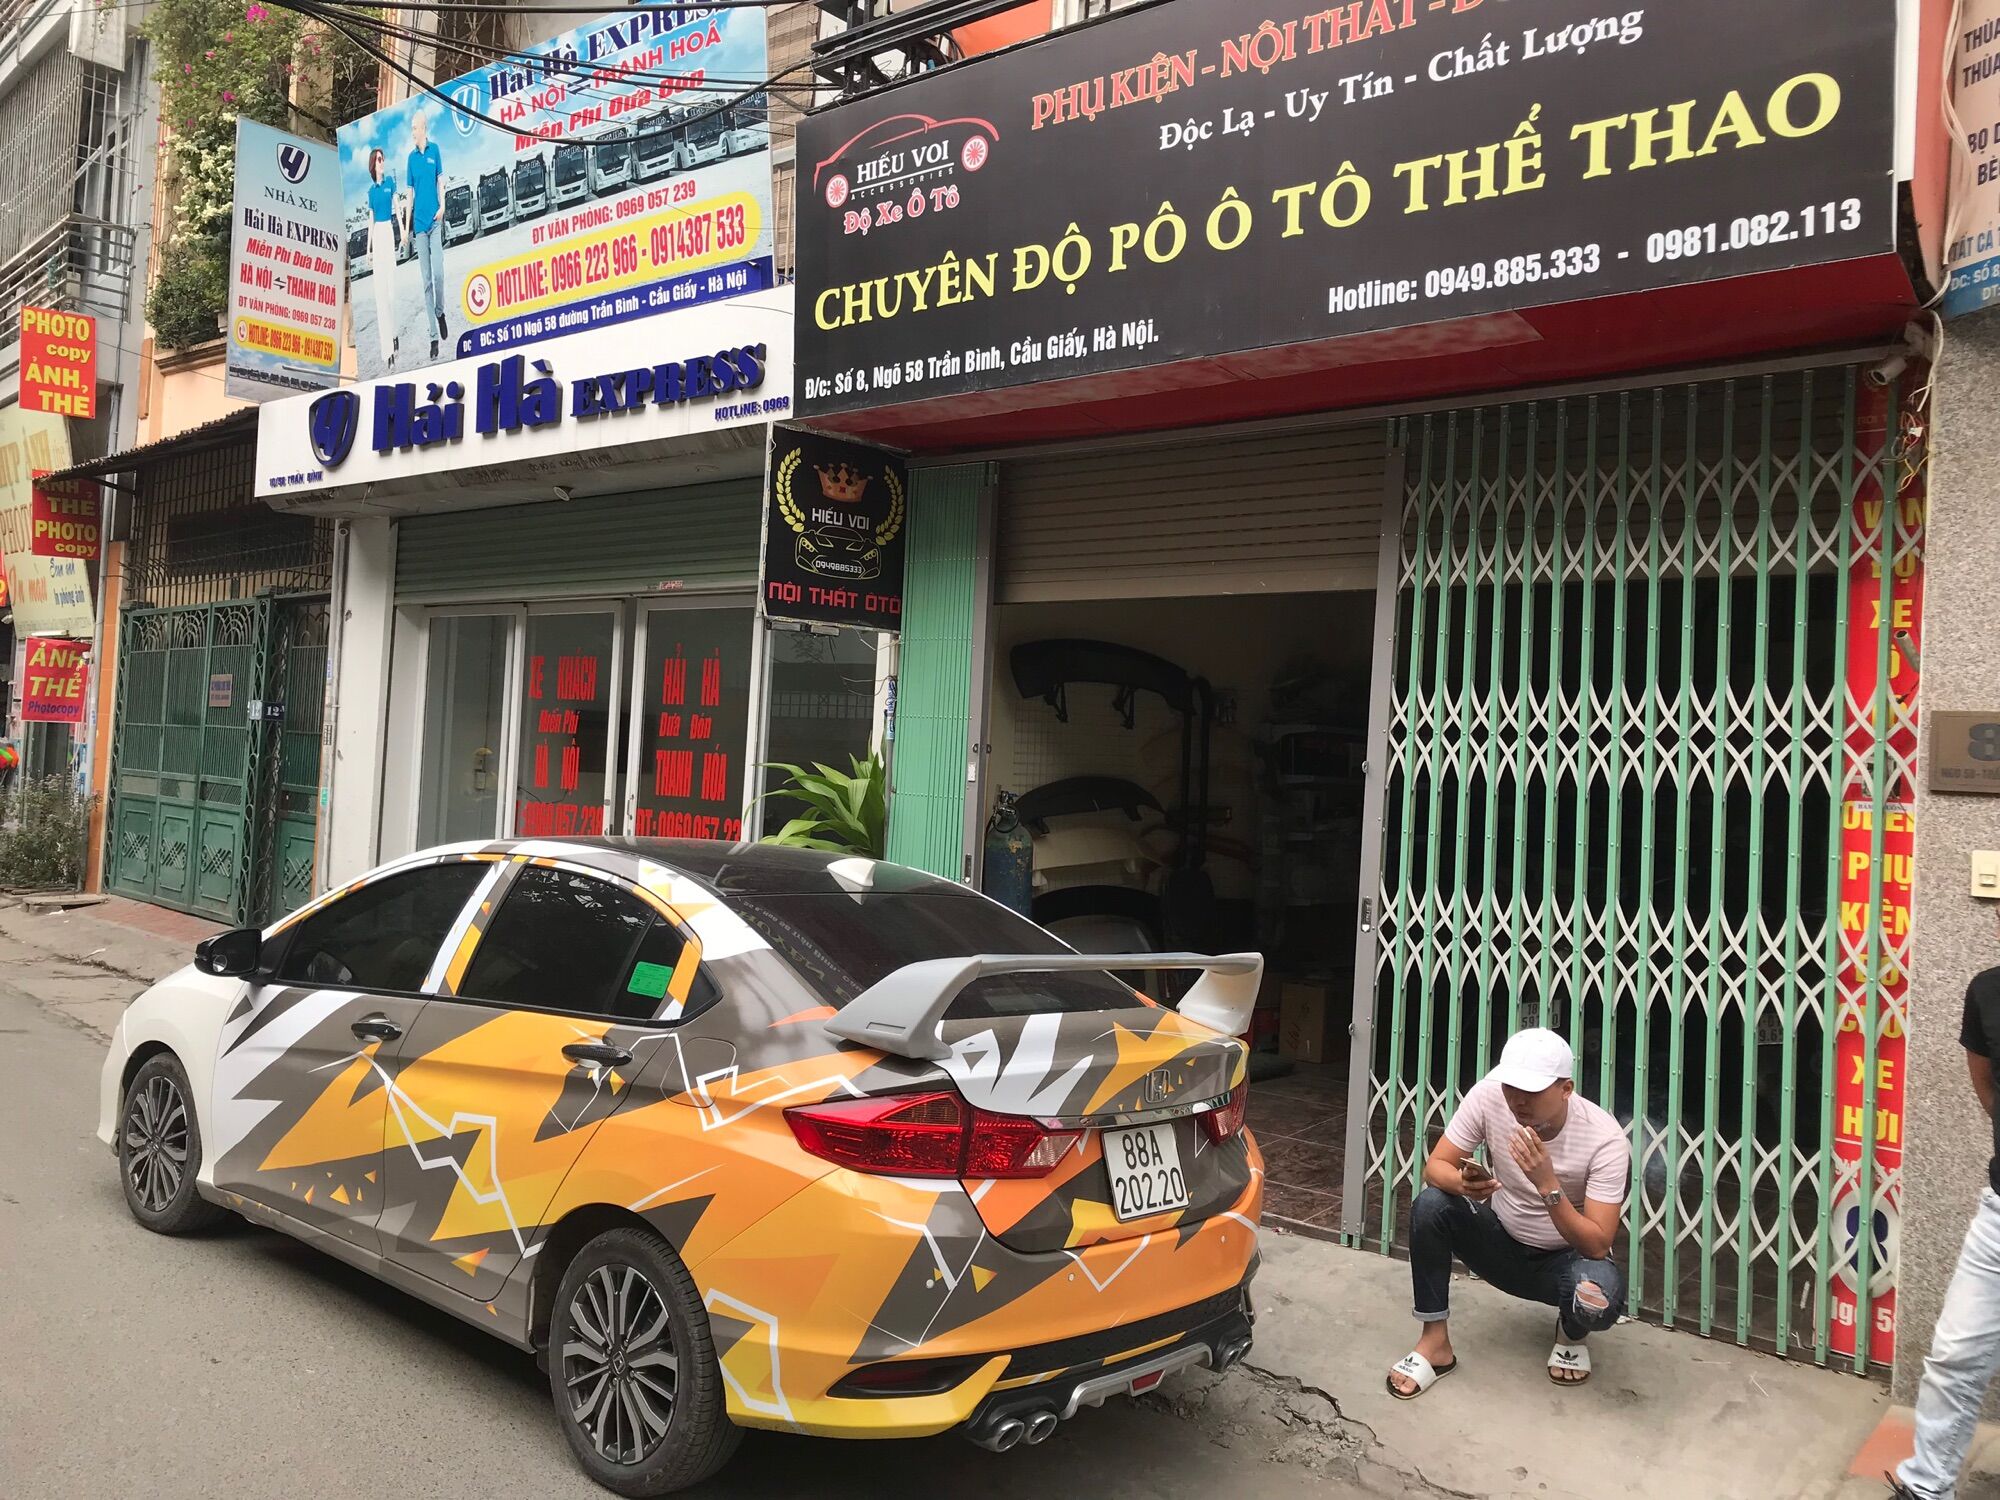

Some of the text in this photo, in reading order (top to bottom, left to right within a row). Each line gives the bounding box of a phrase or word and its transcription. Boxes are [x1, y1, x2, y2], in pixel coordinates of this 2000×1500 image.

[490, 59, 534, 100] Hải
[542, 43, 578, 79] Hà
[592, 21, 722, 90] THANH HOÁ
[1031, 78, 1103, 131] PHỤ
[1110, 51, 1197, 108] KIỆN
[1220, 21, 1296, 77] NỘI
[569, 103, 603, 132] Phí
[608, 88, 653, 119] Đưa
[658, 68, 705, 99] Đón
[1159, 9, 1645, 150] Độc Lạ Uy Tín Chất Lượng
[501, 84, 566, 123] HÀ NỘI
[850, 167, 954, 201] ACCESSORIES
[856, 139, 949, 184] HIẾU VOI
[264, 186, 318, 212] NHÀ XE
[532, 179, 696, 245] ĐT VĂN PHÒNG: 0969 057 239
[814, 72, 1842, 331] CHUYÊN ĐỘ PÔ Ô TÔ THỂ THAO
[844, 184, 960, 236] Độ Xe Ô Tô
[244, 207, 339, 252] Hải Hà EXPRESS
[273, 245, 291, 264] Phí
[496, 203, 745, 308] HOTLINE: 0966 223 966 0914387 533
[1328, 198, 1862, 315] Hotline: 0949.885.333 0981.082.113
[240, 262, 336, 307] HÀ NỘI THANH HOÁ
[23, 309, 90, 341] PHOTO
[480, 268, 747, 347] ĐC: Số 10 Ngõ 58 đường Trần Bình Cầu Giấy Hà Nội
[25, 356, 80, 388] ẢNH
[46, 344, 91, 363] copy
[805, 319, 1159, 400] Đ/c: Số 8, Ngõ 58 Trần Bình, Cầu Giấy, Hà Nội.
[38, 385, 90, 416] THẺ
[372, 343, 767, 455] Hải Hà EXPRESS
[715, 396, 790, 421] HOTLINE: 0969
[35, 519, 97, 541] PHOTO
[811, 505, 870, 531] HIẾU VOI
[55, 543, 97, 557] copy
[815, 560, 863, 574] 0949885333
[769, 581, 802, 604] NỘI
[808, 586, 859, 608] THẤT
[29, 672, 82, 698] THẺ
[28, 701, 79, 717] Photocopy
[656, 750, 693, 798] THANH
[1121, 1129, 1162, 1169] 88A
[1115, 1167, 1185, 1215] 202.20
